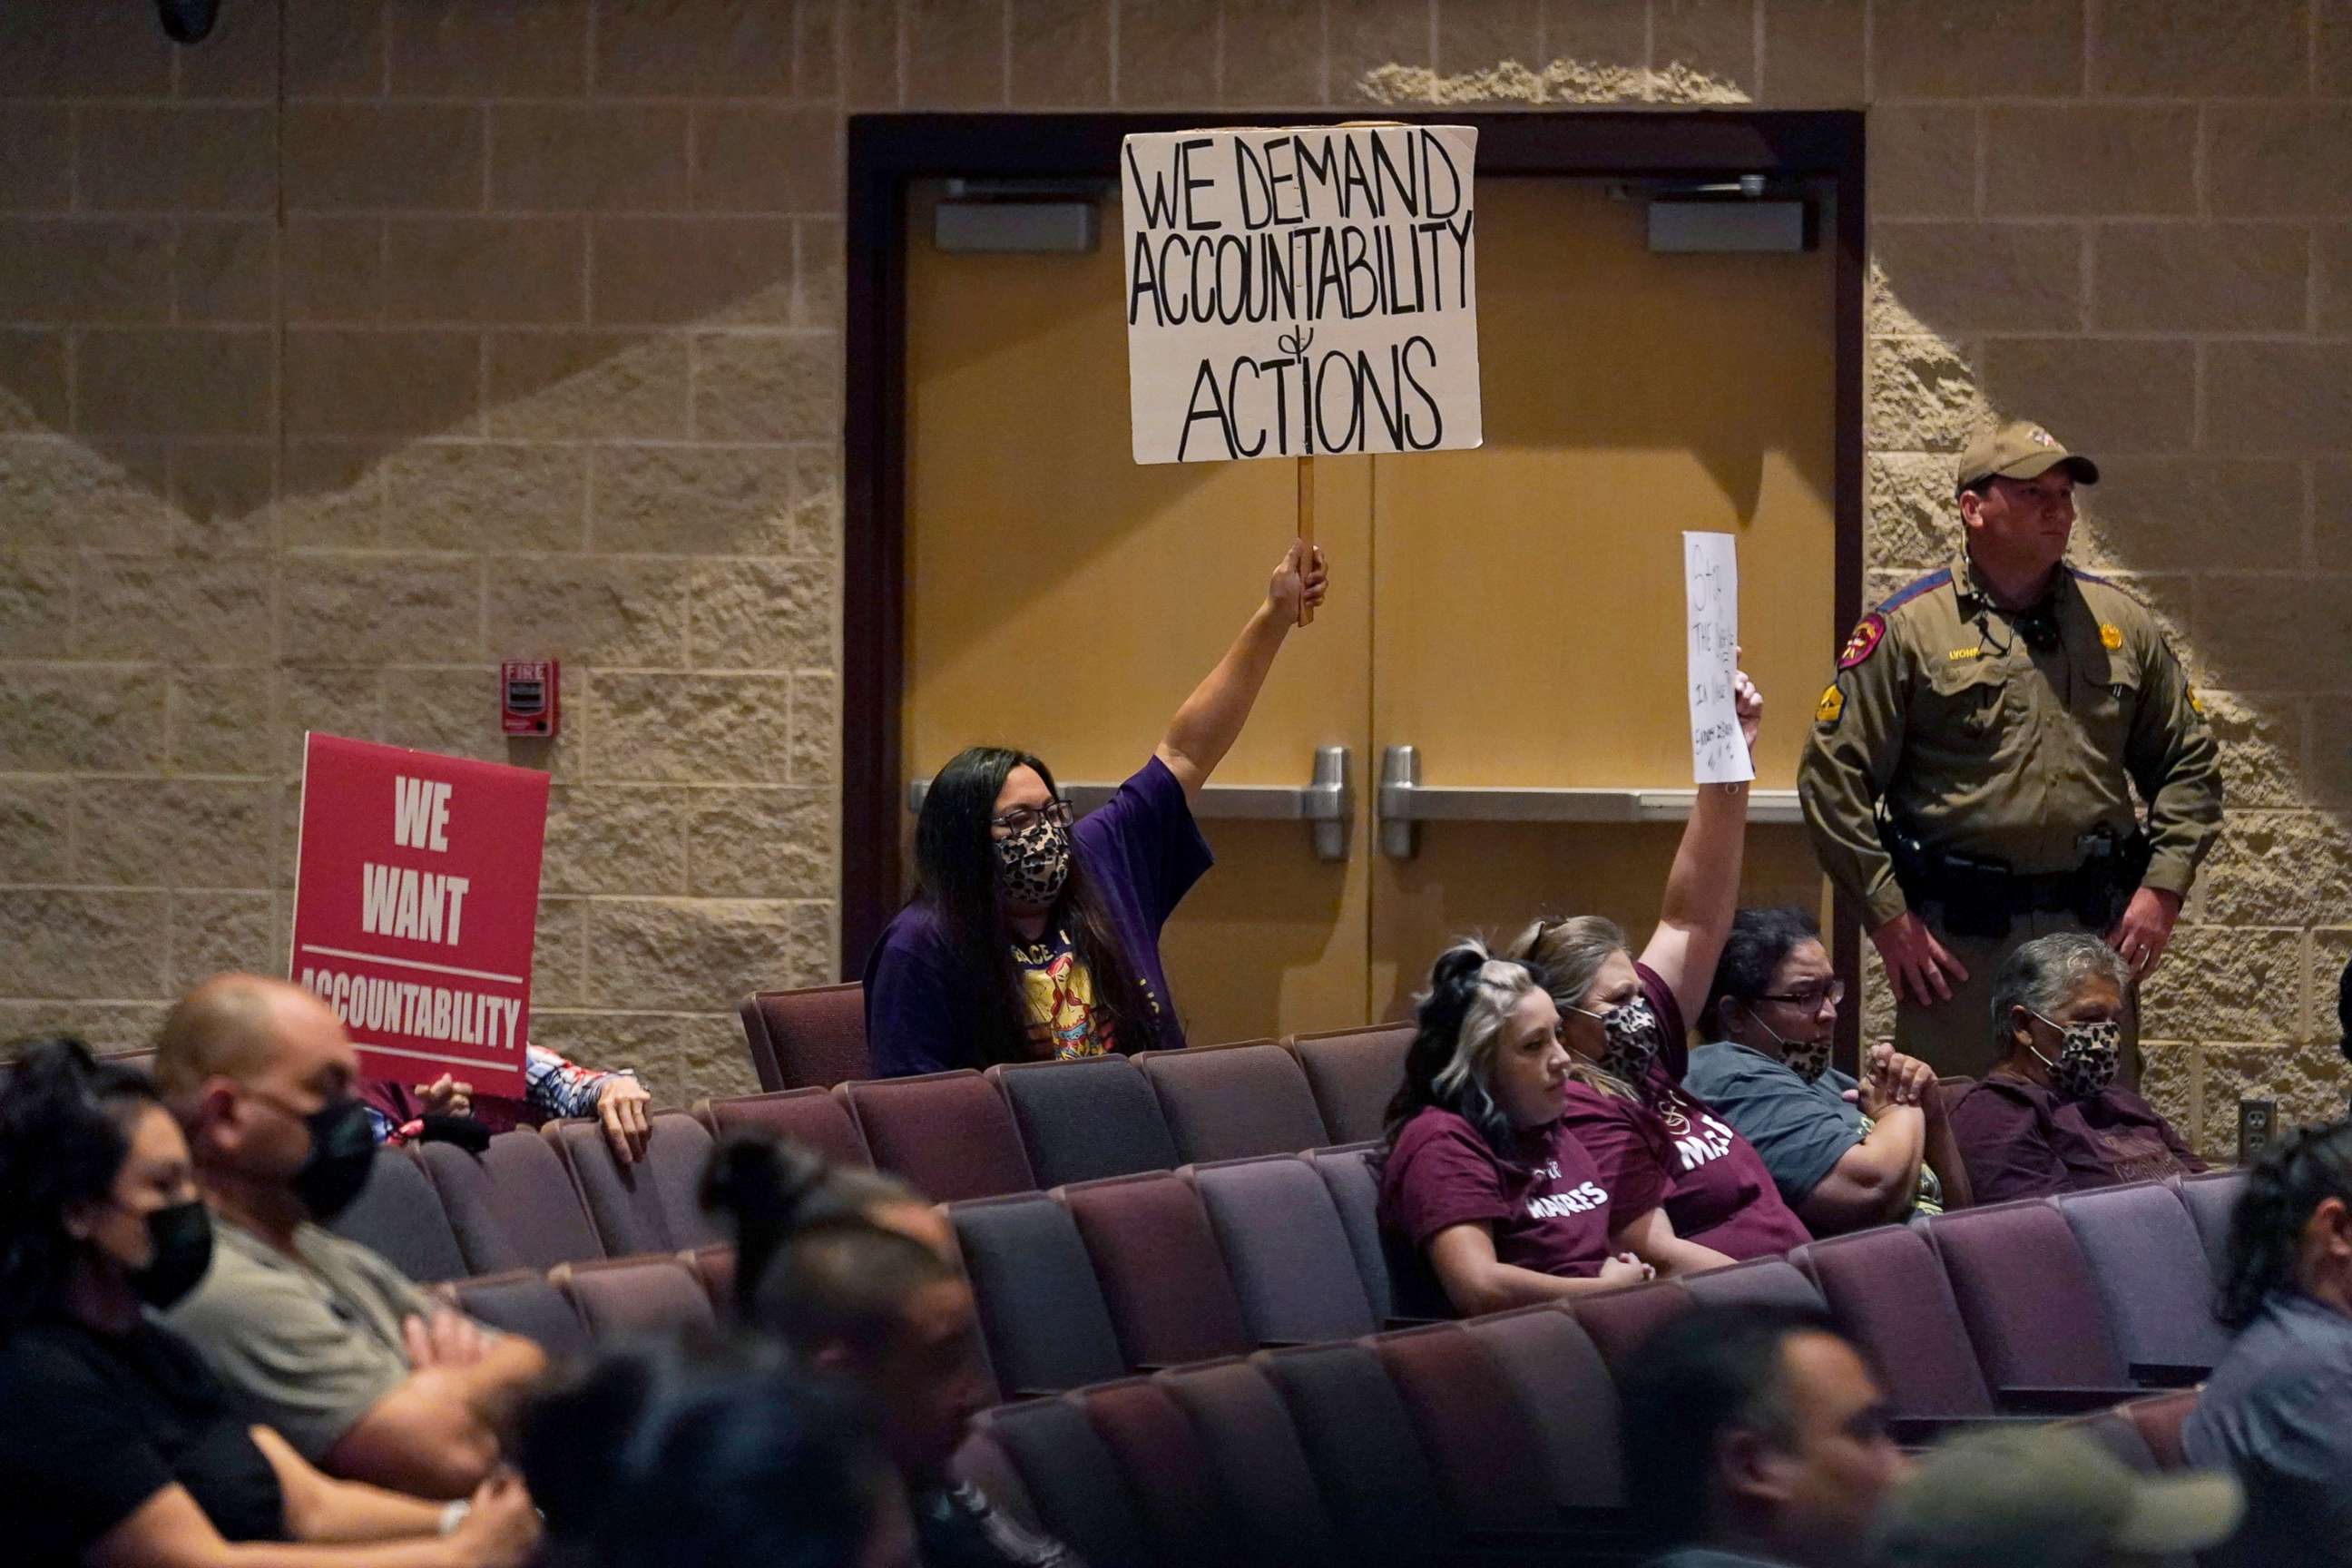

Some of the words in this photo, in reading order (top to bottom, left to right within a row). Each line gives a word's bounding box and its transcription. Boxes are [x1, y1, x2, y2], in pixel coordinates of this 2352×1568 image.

[1126, 137, 1221, 230] WE
[1234, 128, 1461, 230] DEMAND
[1129, 210, 1474, 327] ACCOUNTABILITY
[1177, 335, 1443, 462] ACTIONS
[393, 775, 453, 853] WE
[362, 862, 470, 946] WANT
